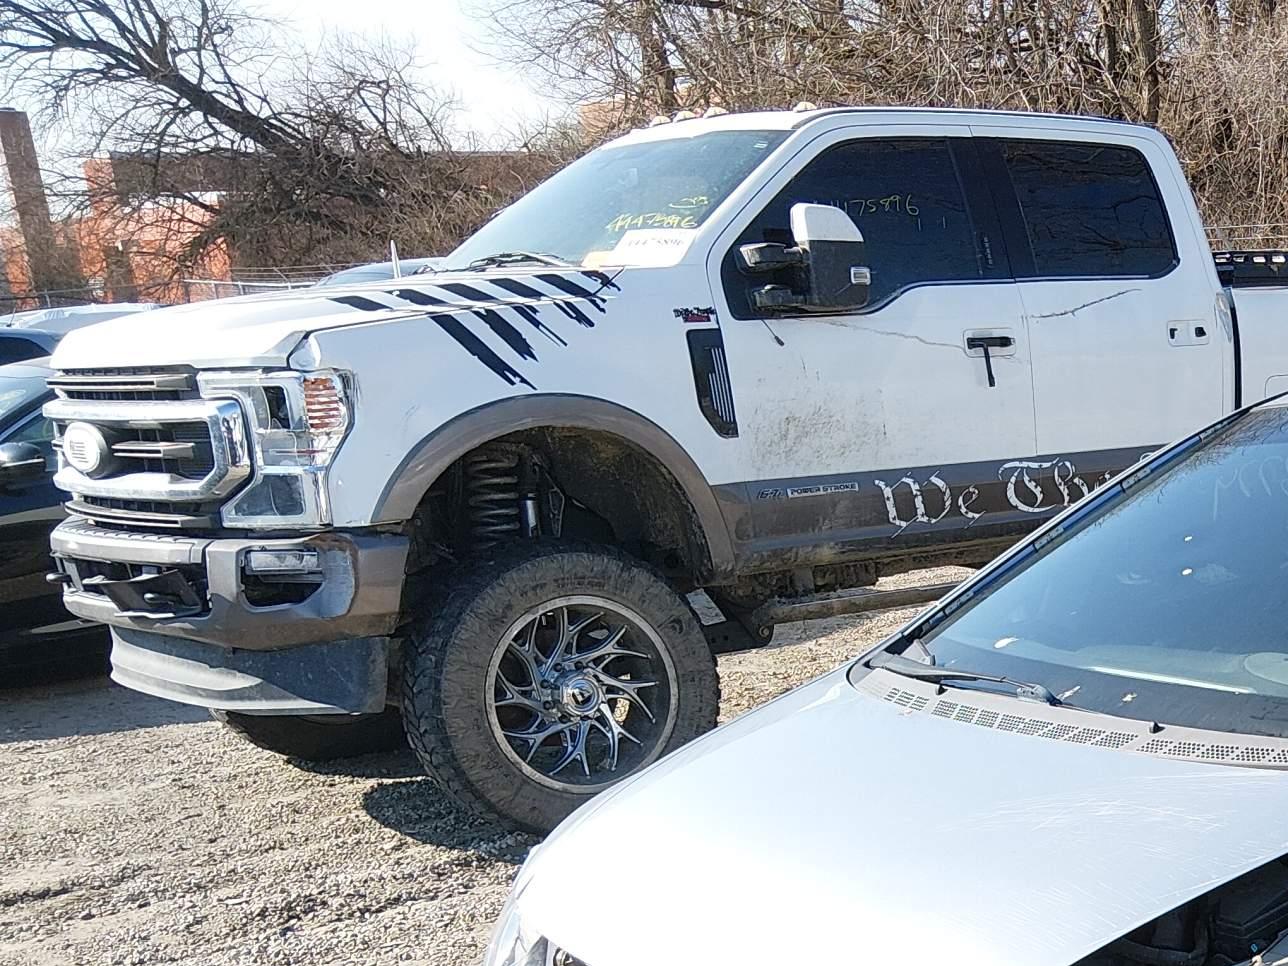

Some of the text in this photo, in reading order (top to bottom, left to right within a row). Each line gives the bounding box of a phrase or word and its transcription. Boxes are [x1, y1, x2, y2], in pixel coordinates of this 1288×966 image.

[790, 486, 821, 496] POWER
[822, 483, 857, 493] STROKE
[873, 469, 987, 539] We
